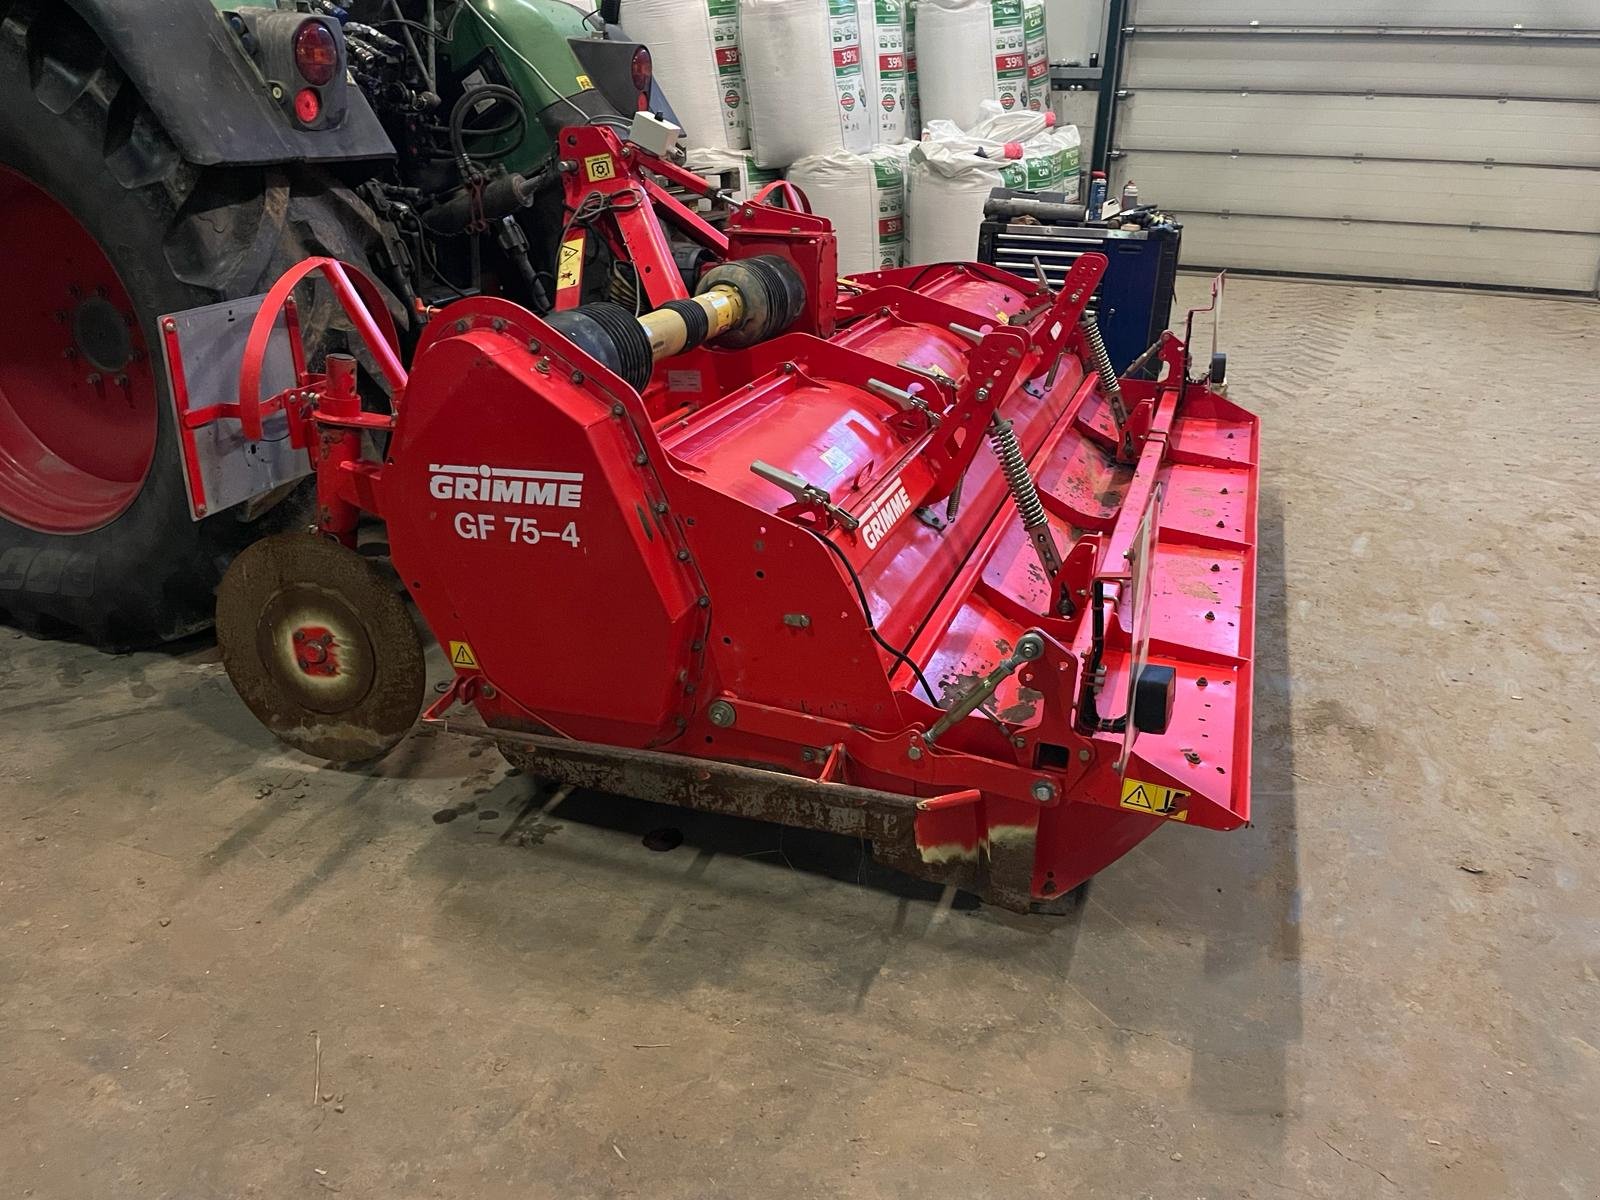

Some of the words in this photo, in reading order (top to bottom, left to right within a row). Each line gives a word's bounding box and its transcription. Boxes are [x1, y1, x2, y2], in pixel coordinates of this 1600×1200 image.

[841, 50, 857, 65] 39%
[887, 57, 902, 69] 39%
[1004, 56, 1023, 68] 39%
[429, 464, 583, 508] GRIMME
[454, 512, 495, 540] GF
[504, 516, 580, 548] 75-4
[862, 486, 912, 550] GRIMME
